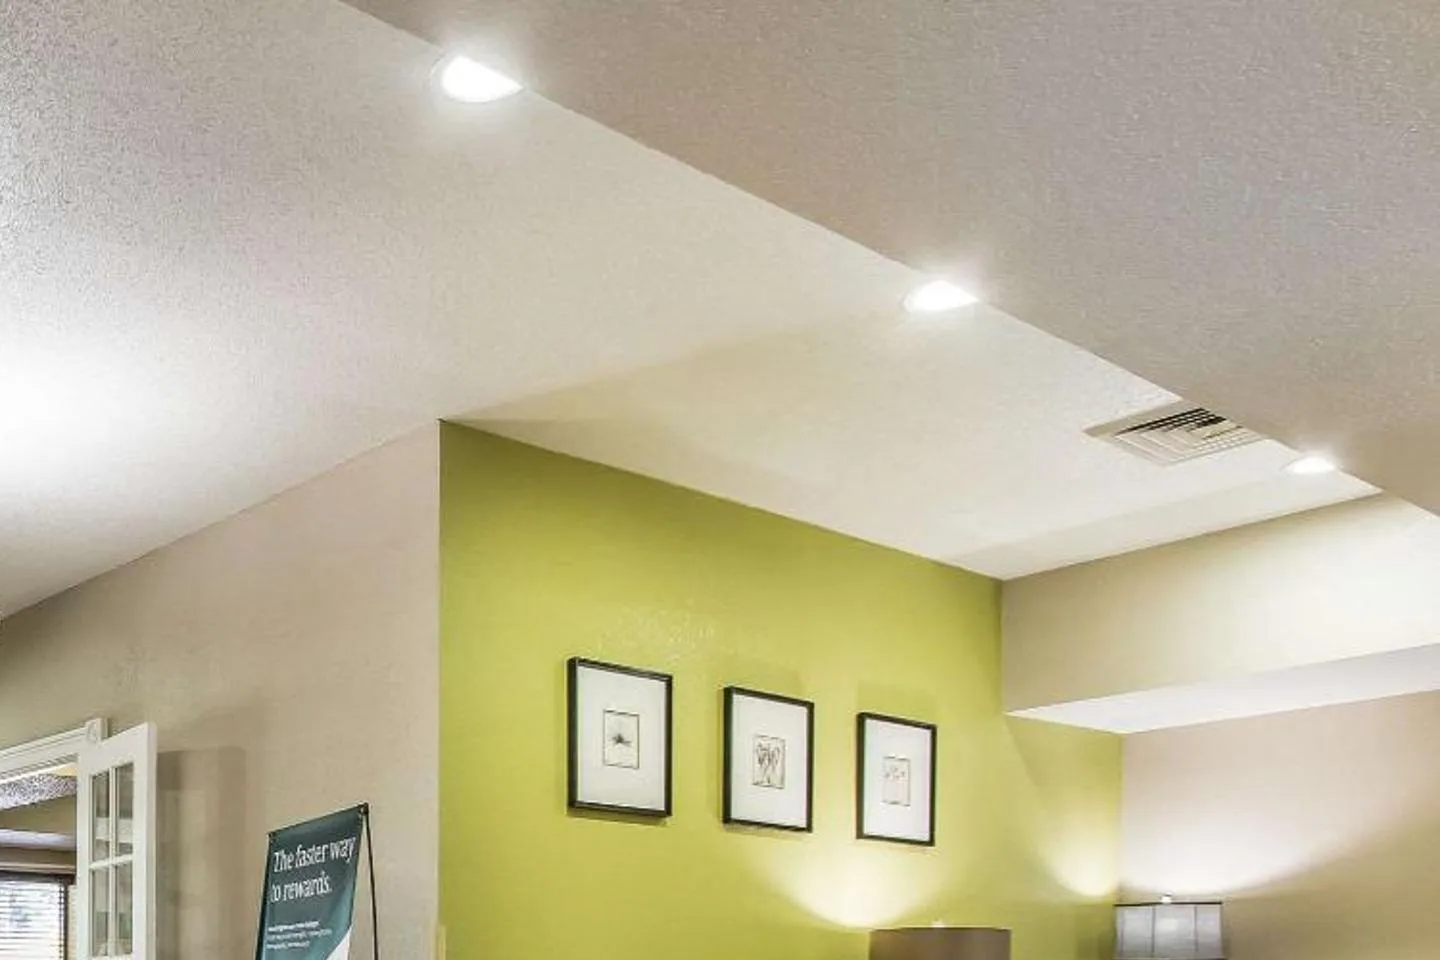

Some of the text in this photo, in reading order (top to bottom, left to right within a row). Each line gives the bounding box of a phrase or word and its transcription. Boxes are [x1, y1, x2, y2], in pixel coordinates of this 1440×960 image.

[273, 836, 356, 873] The faster way
[271, 884, 281, 902] to
